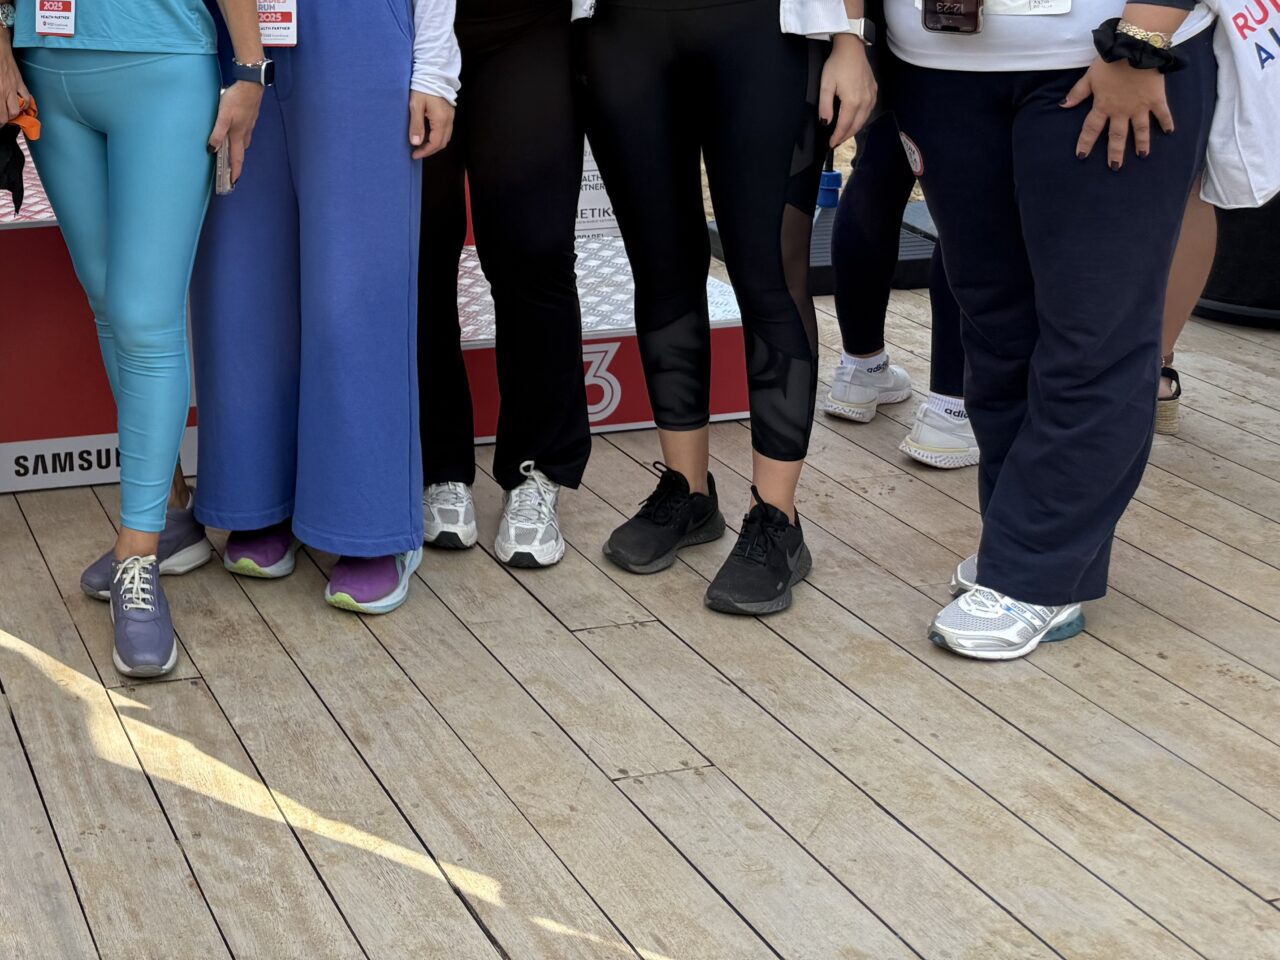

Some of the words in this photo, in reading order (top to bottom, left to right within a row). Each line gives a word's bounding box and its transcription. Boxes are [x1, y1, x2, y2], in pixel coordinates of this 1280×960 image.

[43, 1, 64, 11] 2025
[257, 3, 276, 11] RUN
[258, 12, 282, 22] 2025
[581, 341, 622, 423] 3
[14, 448, 121, 477] SAMSU
